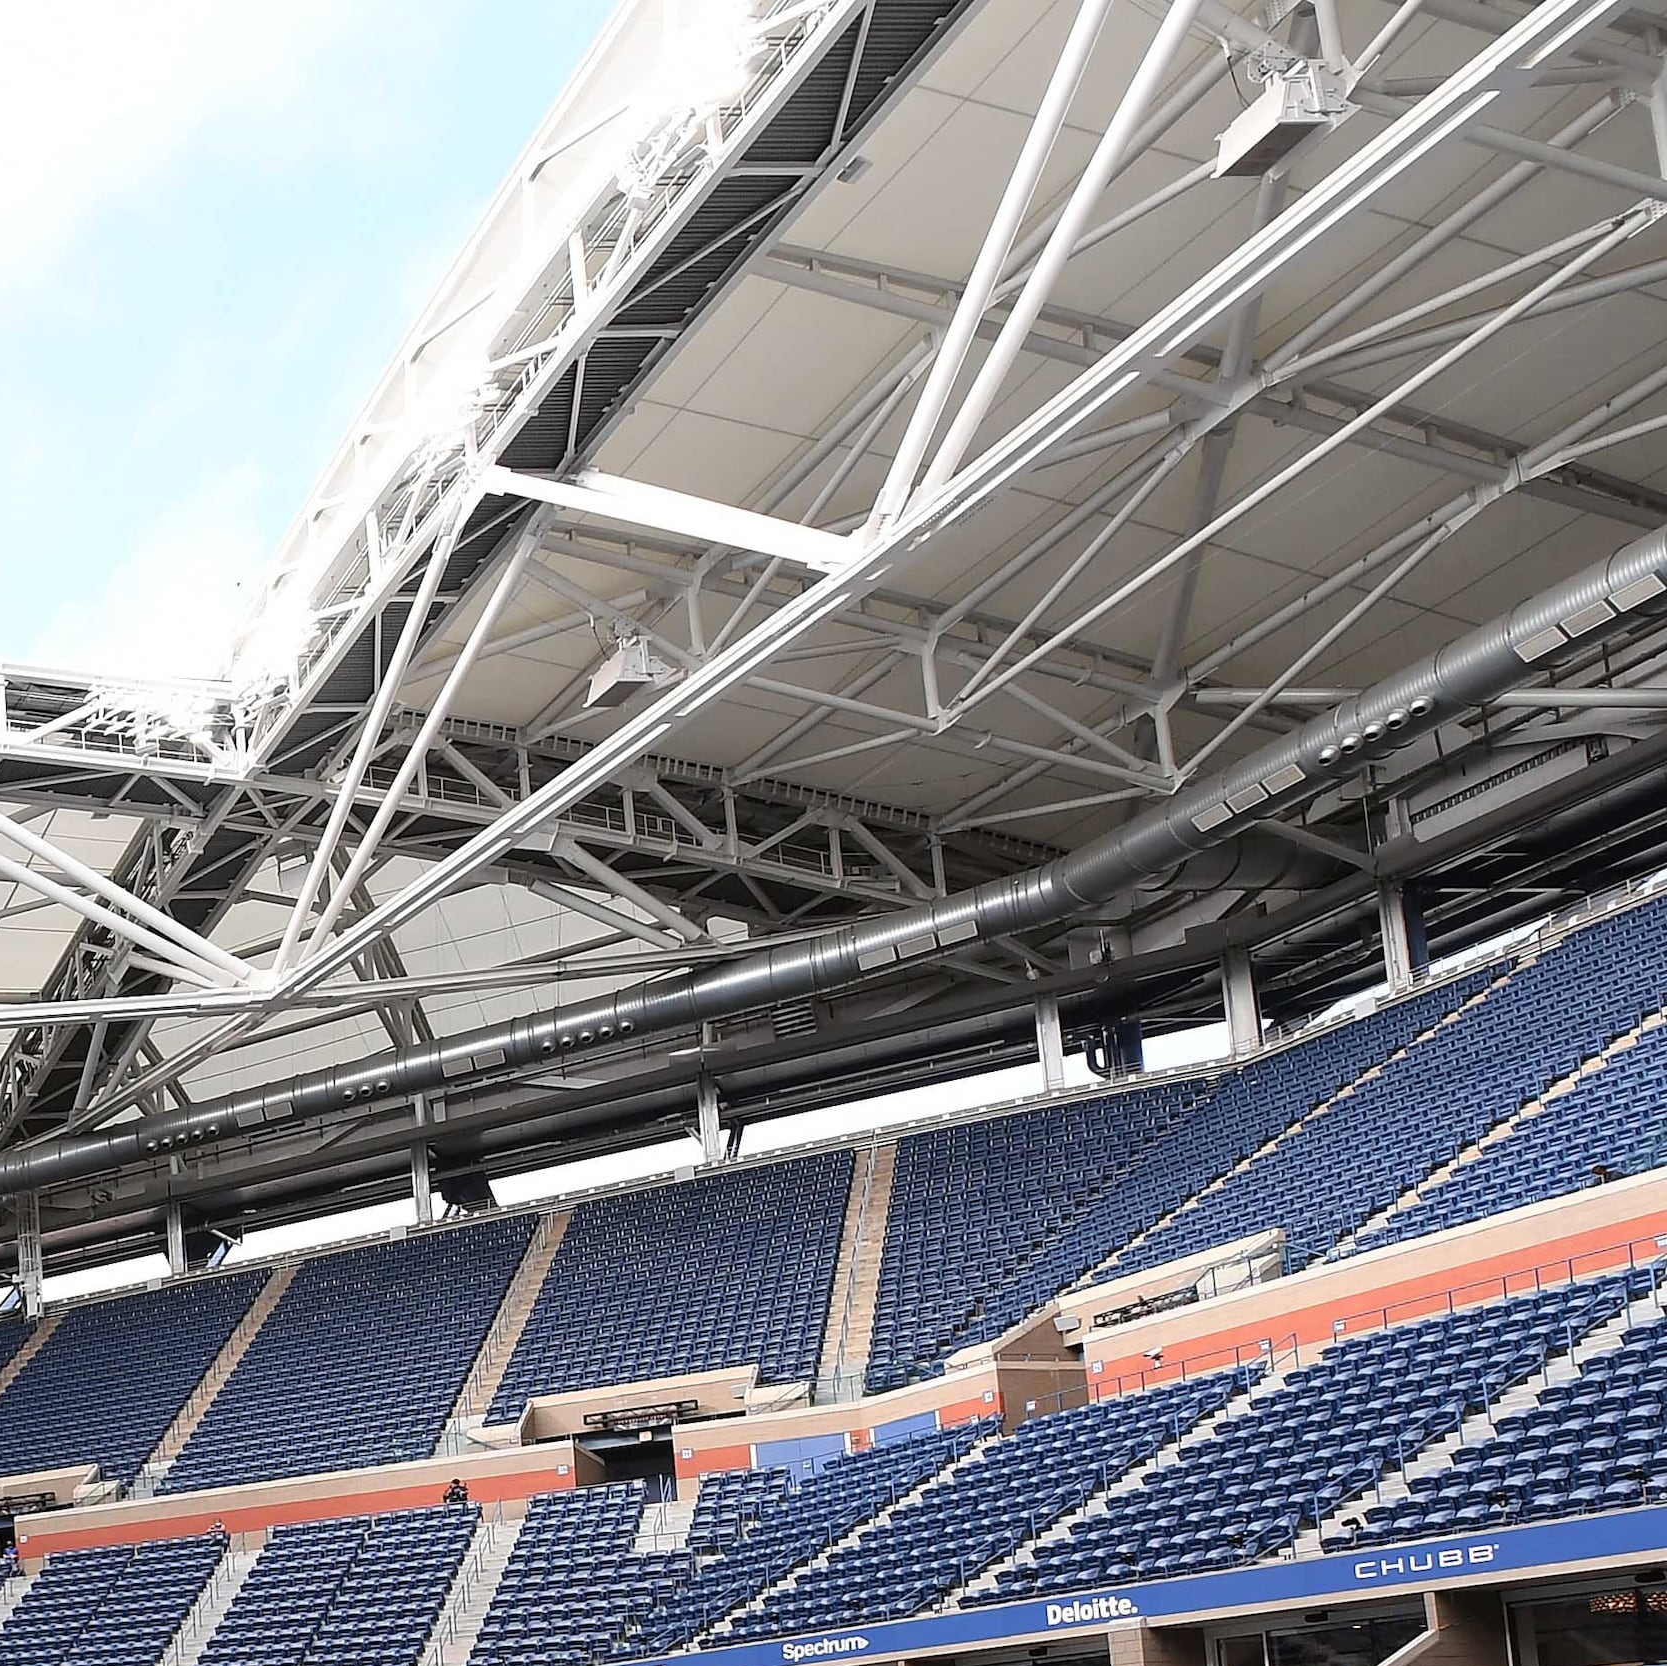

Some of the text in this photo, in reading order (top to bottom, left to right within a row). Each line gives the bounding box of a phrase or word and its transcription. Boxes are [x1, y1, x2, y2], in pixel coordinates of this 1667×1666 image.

[1355, 1546, 1495, 1579] CHUBB
[1047, 1597, 1137, 1626] Deloitte.
[782, 1637, 862, 1659] Spectrum
